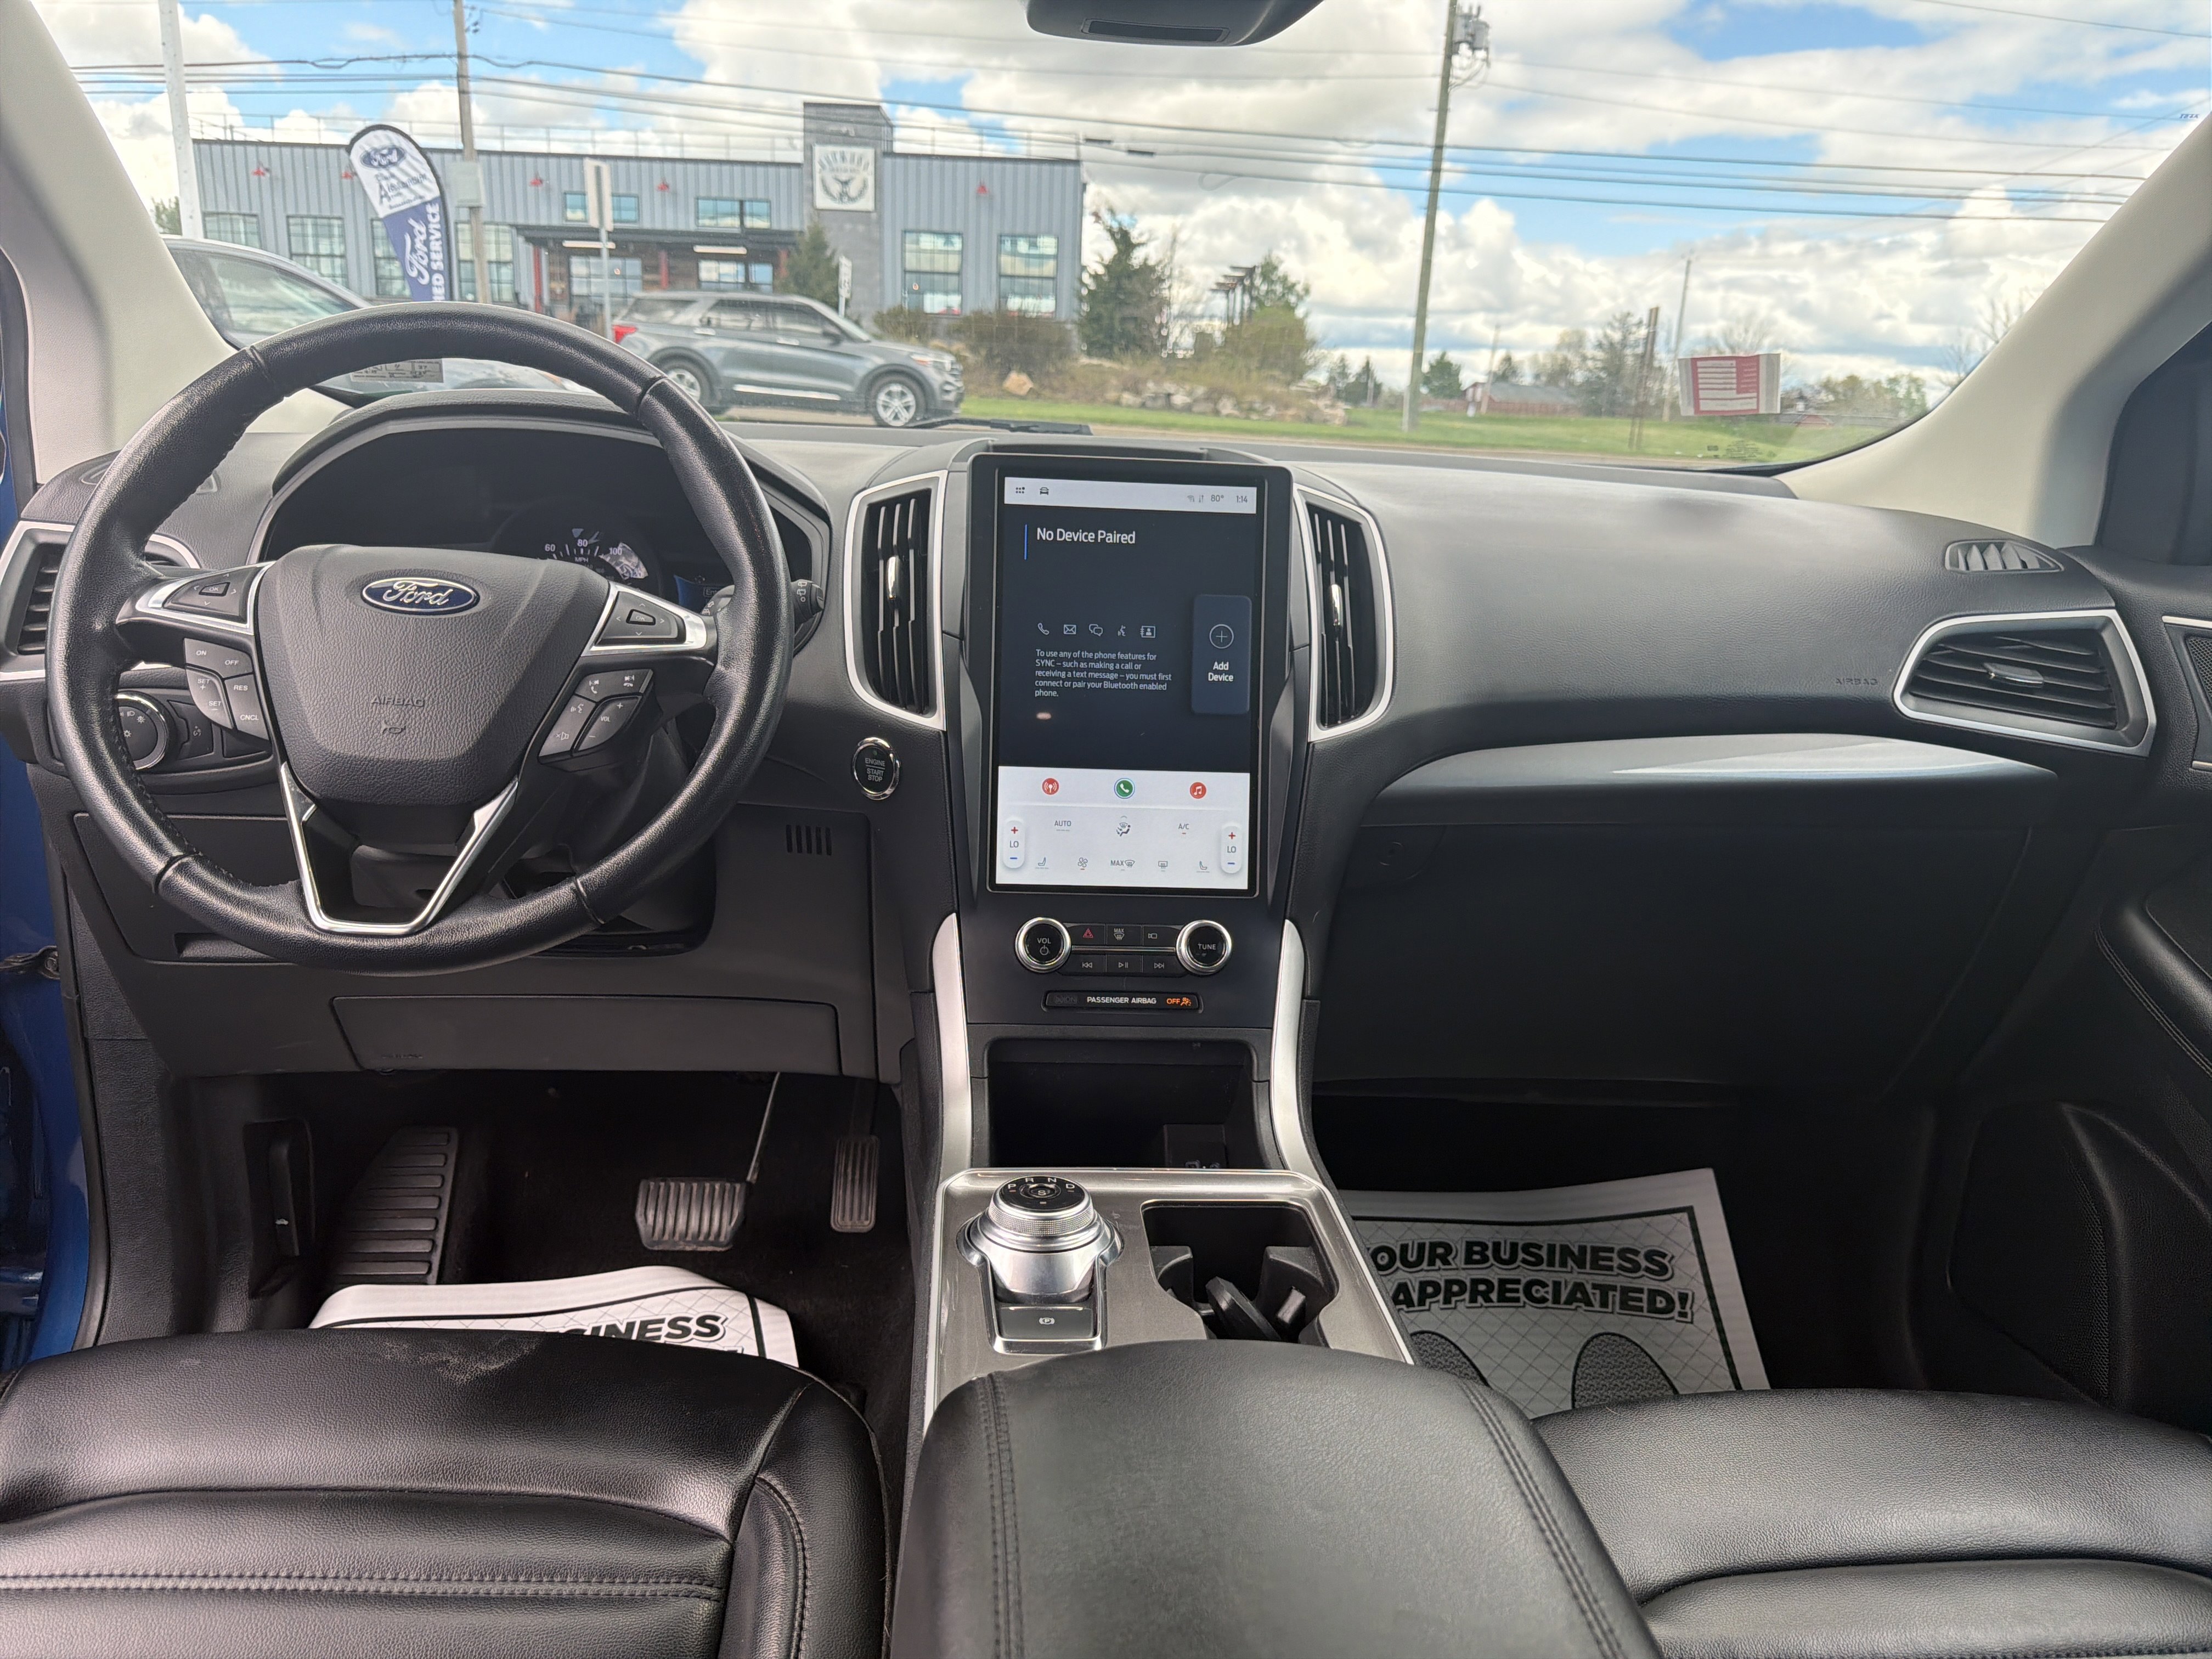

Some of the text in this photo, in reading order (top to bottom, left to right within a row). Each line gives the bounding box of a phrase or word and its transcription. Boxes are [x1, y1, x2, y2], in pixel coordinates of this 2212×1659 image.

[425, 203, 444, 271] SERVICE
[404, 217, 430, 285] Ford
[1236, 495, 1248, 504] 1:14
[1037, 527, 1136, 544] No Device Paired
[545, 543, 556, 552] 60
[577, 539, 589, 548] 80
[609, 547, 623, 556] 100
[383, 580, 454, 606] Ford
[1036, 649, 1045, 657] To
[1059, 652, 1071, 660] any
[1081, 651, 1093, 659] the
[1094, 652, 1116, 661] phone
[1118, 652, 1146, 661] features
[1035, 659, 1055, 667] SYNC
[1062, 660, 1079, 668] such
[1088, 662, 1114, 671] making
[1121, 662, 1133, 670] call
[1212, 661, 1229, 670] Add
[1035, 670, 1066, 679] receiving
[1088, 672, 1119, 680] message
[1139, 673, 1157, 681] must
[1158, 673, 1172, 681] first
[1208, 672, 1234, 682] Device
[1073, 680, 1086, 689] pair
[1087, 681, 1102, 690] your
[1103, 681, 1138, 690] Bluetooth
[1139, 682, 1167, 691] enabled
[1035, 689, 1059, 698] phone.
[370, 696, 425, 707] AIRBAG
[865, 758, 885, 766] ENGINE
[866, 768, 884, 776] START
[1227, 845, 1237, 854] LO
[1368, 1240, 1670, 1277] OUR BUSINESS
[1391, 1277, 1691, 1320] APPRECIATED!
